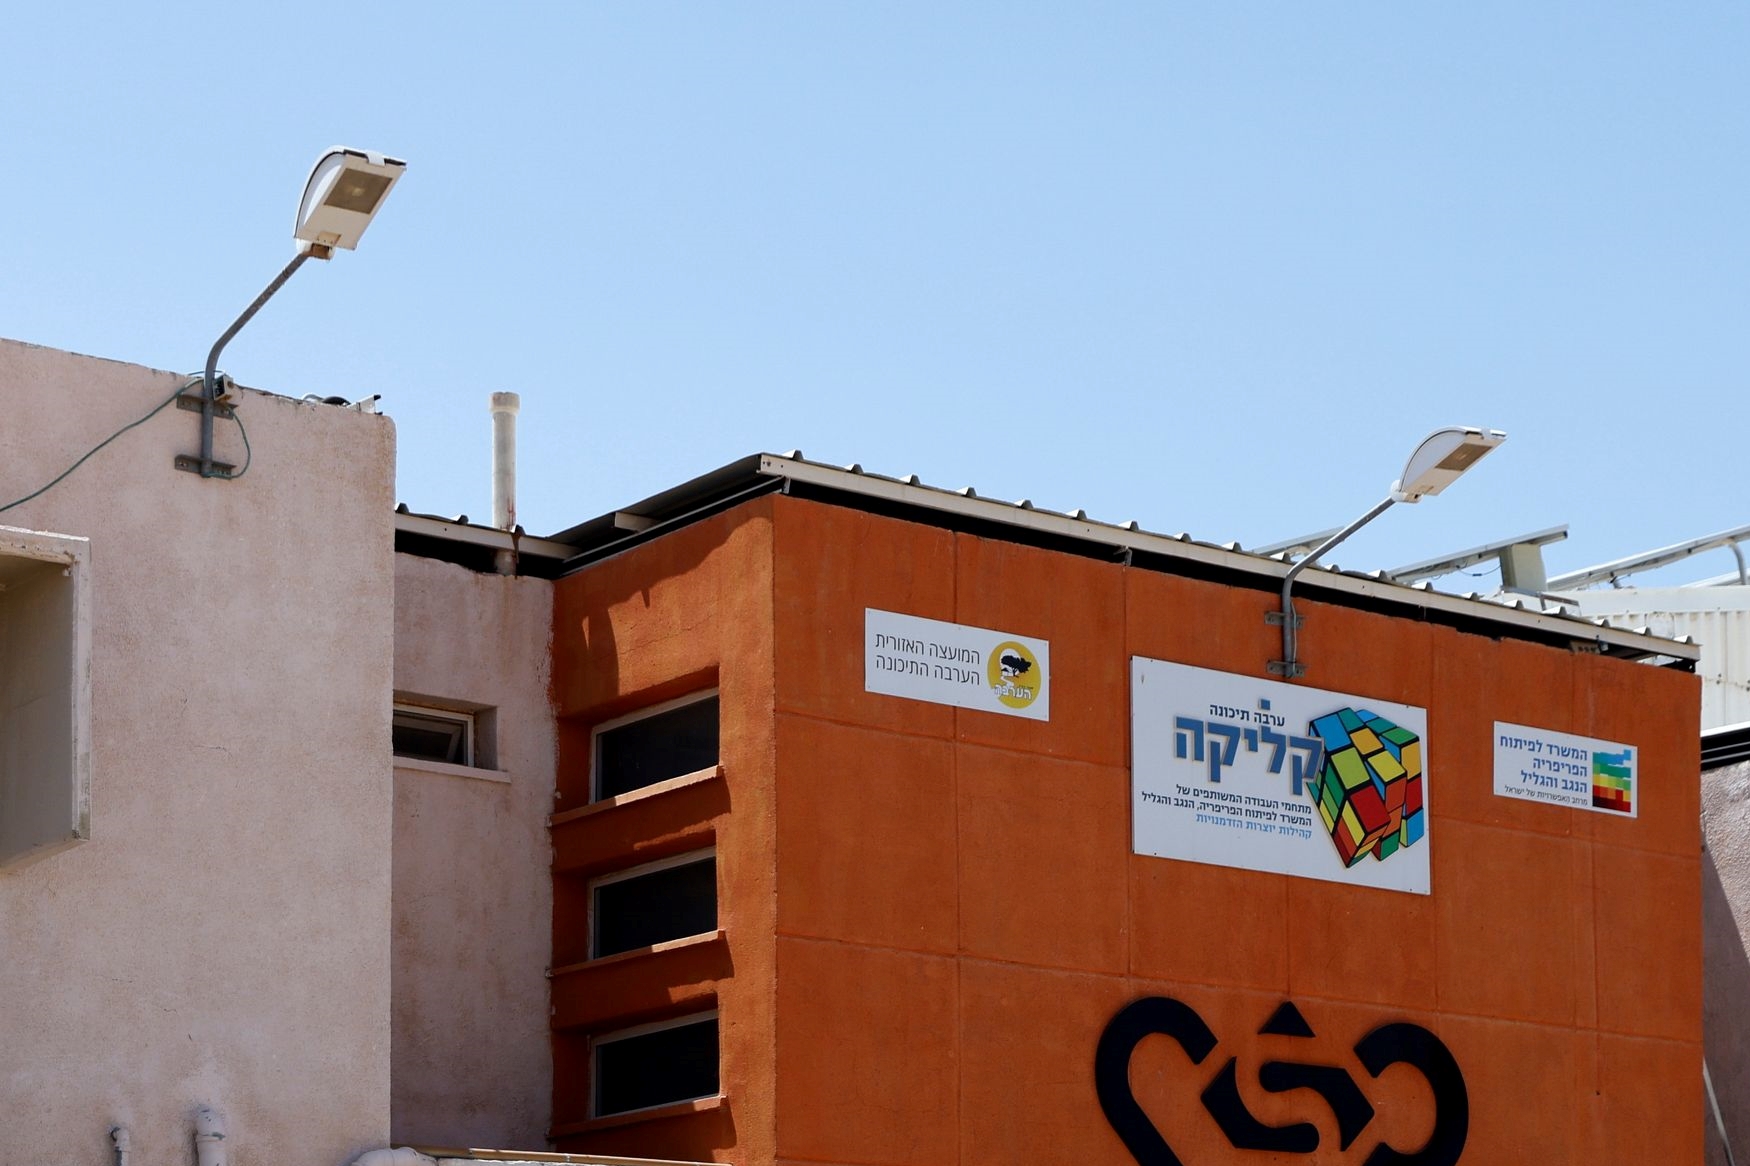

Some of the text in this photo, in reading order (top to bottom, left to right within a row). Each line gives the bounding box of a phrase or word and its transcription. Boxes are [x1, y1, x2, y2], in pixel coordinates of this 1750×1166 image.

[875, 633, 980, 665] המועצה האזורית
[876, 654, 980, 686] הערבה התיכונה
[994, 683, 1033, 701] הערבה
[1209, 703, 1285, 728] ערבה תיכונה
[1175, 699, 1324, 796] קליקה
[1500, 735, 1588, 761] המשרד לפיתוח
[1533, 757, 1588, 778] הפריפריה
[1504, 785, 1525, 795] ישראל
[1521, 770, 1588, 793] הנגב והגליל
[1142, 791, 1172, 806] והגליל
[1176, 784, 1312, 815] מתחמי העבודה המשותפים של
[1526, 788, 1536, 797] של
[1572, 797, 1588, 806] מרחב
[1173, 797, 1195, 810] הנגב
[1245, 808, 1277, 822] לפיתוח
[1280, 813, 1312, 827] המשרד
[1196, 813, 1312, 840] קהילות יוצרות הזדמנויות
